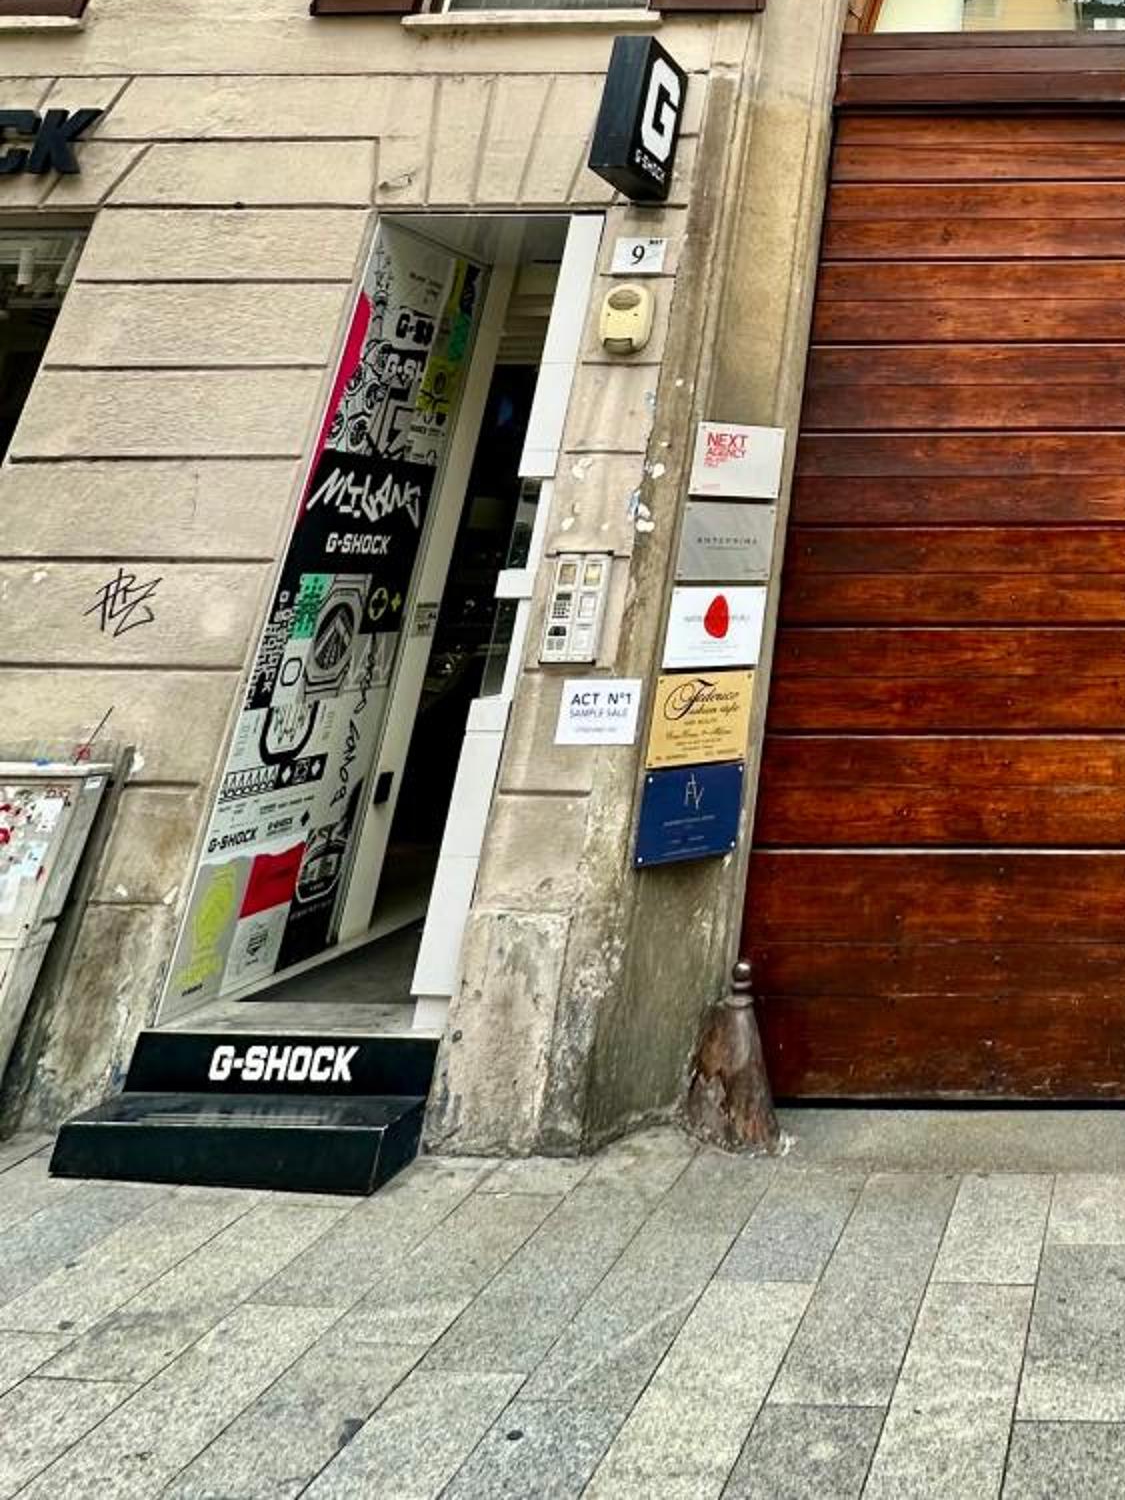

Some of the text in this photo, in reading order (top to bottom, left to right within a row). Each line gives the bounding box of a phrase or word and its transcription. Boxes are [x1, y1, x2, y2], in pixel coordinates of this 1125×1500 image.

[641, 57, 681, 163] G
[630, 244, 646, 266] 9
[707, 432, 749, 447] NEXT
[325, 531, 393, 556] G-SHOCK
[571, 693, 600, 706] ACT
[207, 826, 260, 854] G-SHOCK
[208, 1045, 360, 1082] G-SHOCK
